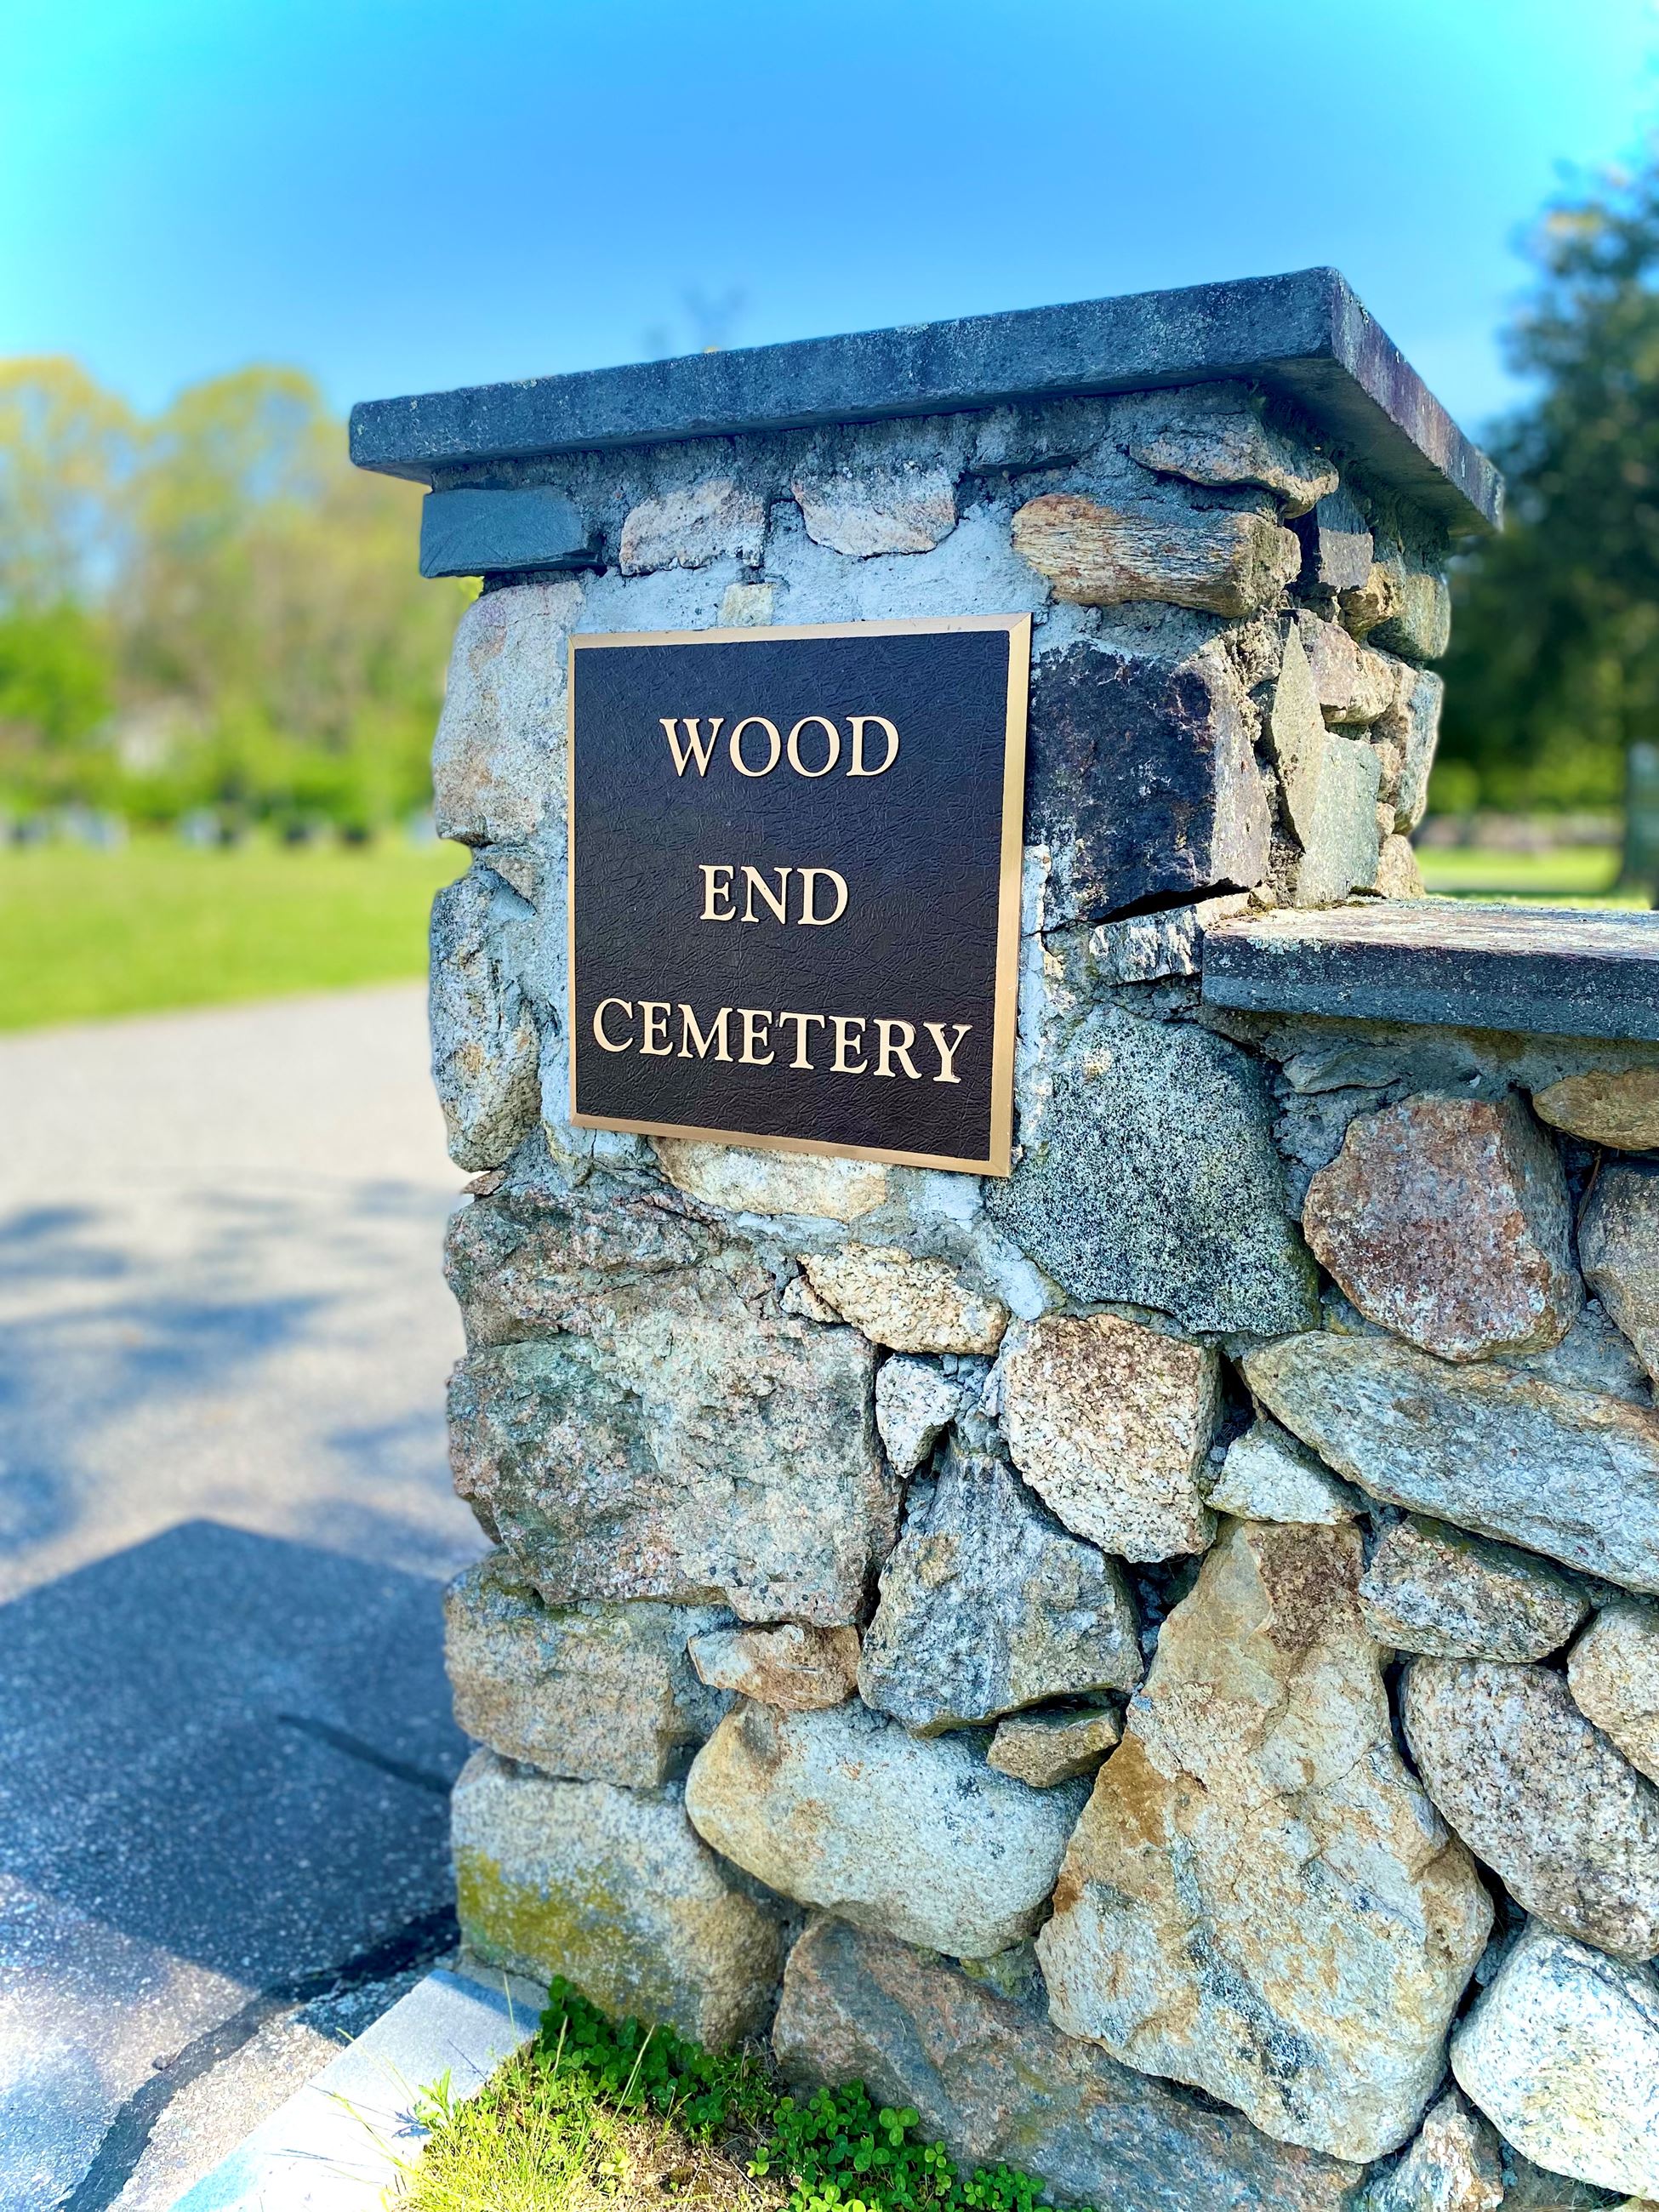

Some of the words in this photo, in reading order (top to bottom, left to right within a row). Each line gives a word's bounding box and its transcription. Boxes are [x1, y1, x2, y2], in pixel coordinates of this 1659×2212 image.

[658, 715, 899, 778] WOOD
[698, 864, 848, 926] END
[593, 997, 973, 1084] CEMETERY
